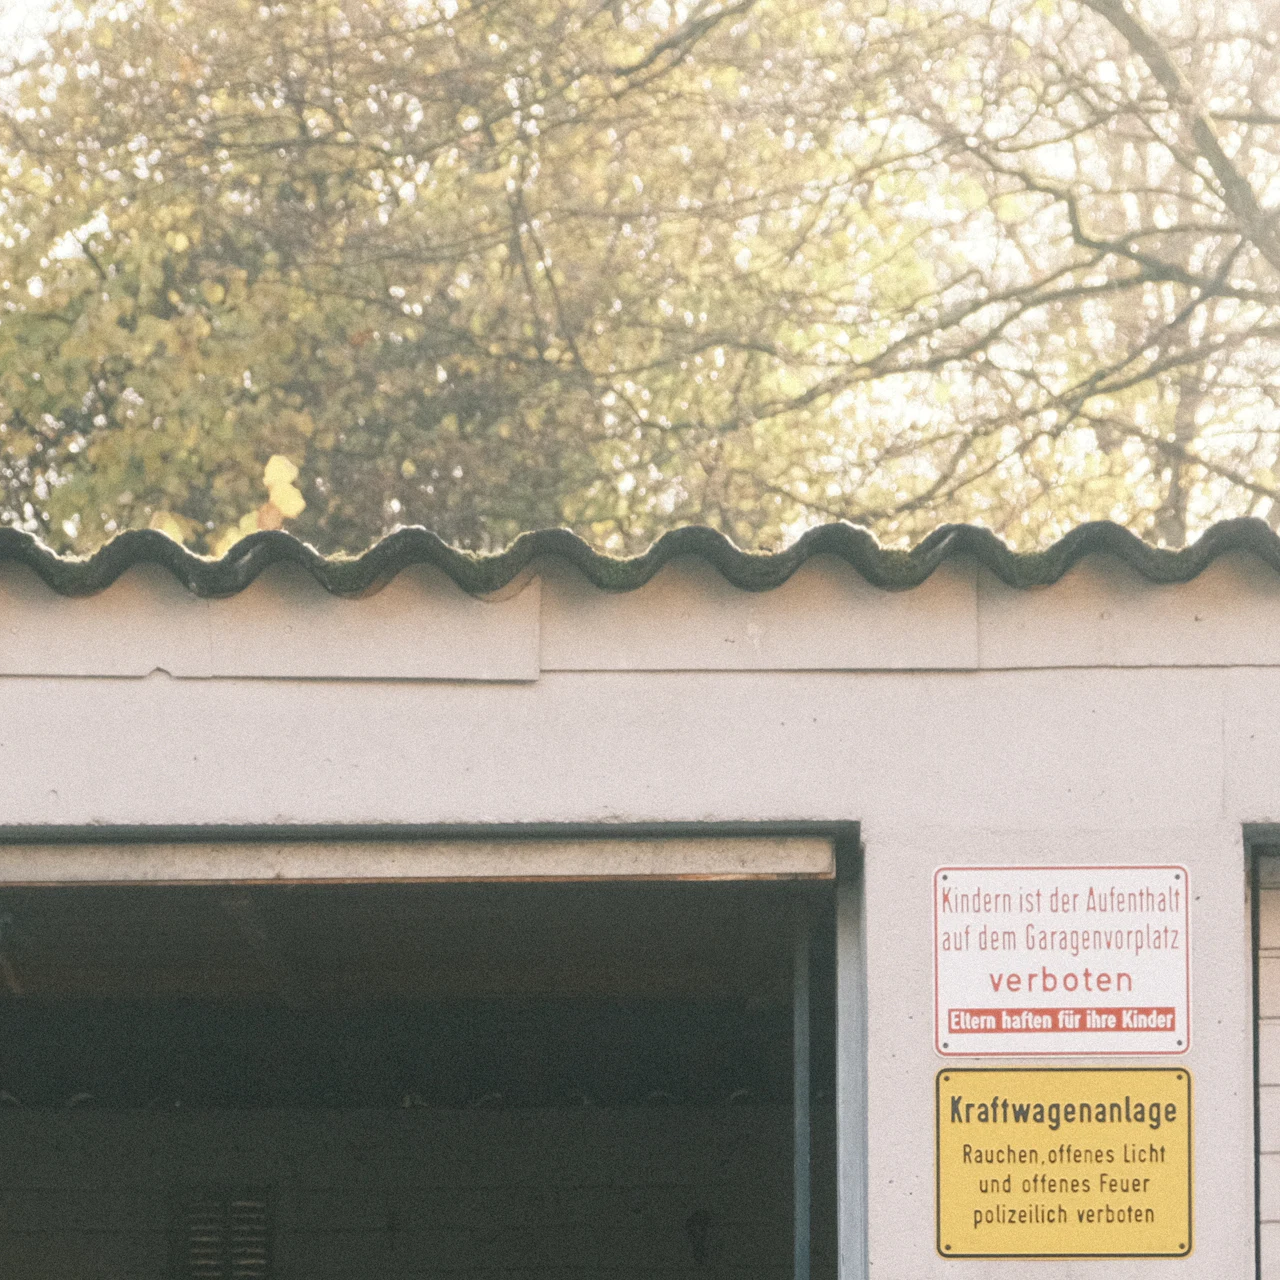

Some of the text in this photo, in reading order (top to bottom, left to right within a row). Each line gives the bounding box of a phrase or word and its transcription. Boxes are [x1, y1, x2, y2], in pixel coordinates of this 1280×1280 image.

[942, 886, 1180, 913] Kindern ist der Aufenthalt
[942, 923, 1179, 956] auf dem Garagenvorplatz
[990, 966, 1132, 992] verboten
[950, 1008, 1173, 1030] Eltern haften für ihre Kinder
[951, 1096, 1177, 1130] Kraftwagenanlage
[1123, 1143, 1166, 1163] Licht
[979, 1173, 1151, 1193] und offenes Feuer
[974, 1204, 1154, 1229] polizeilich verboten
